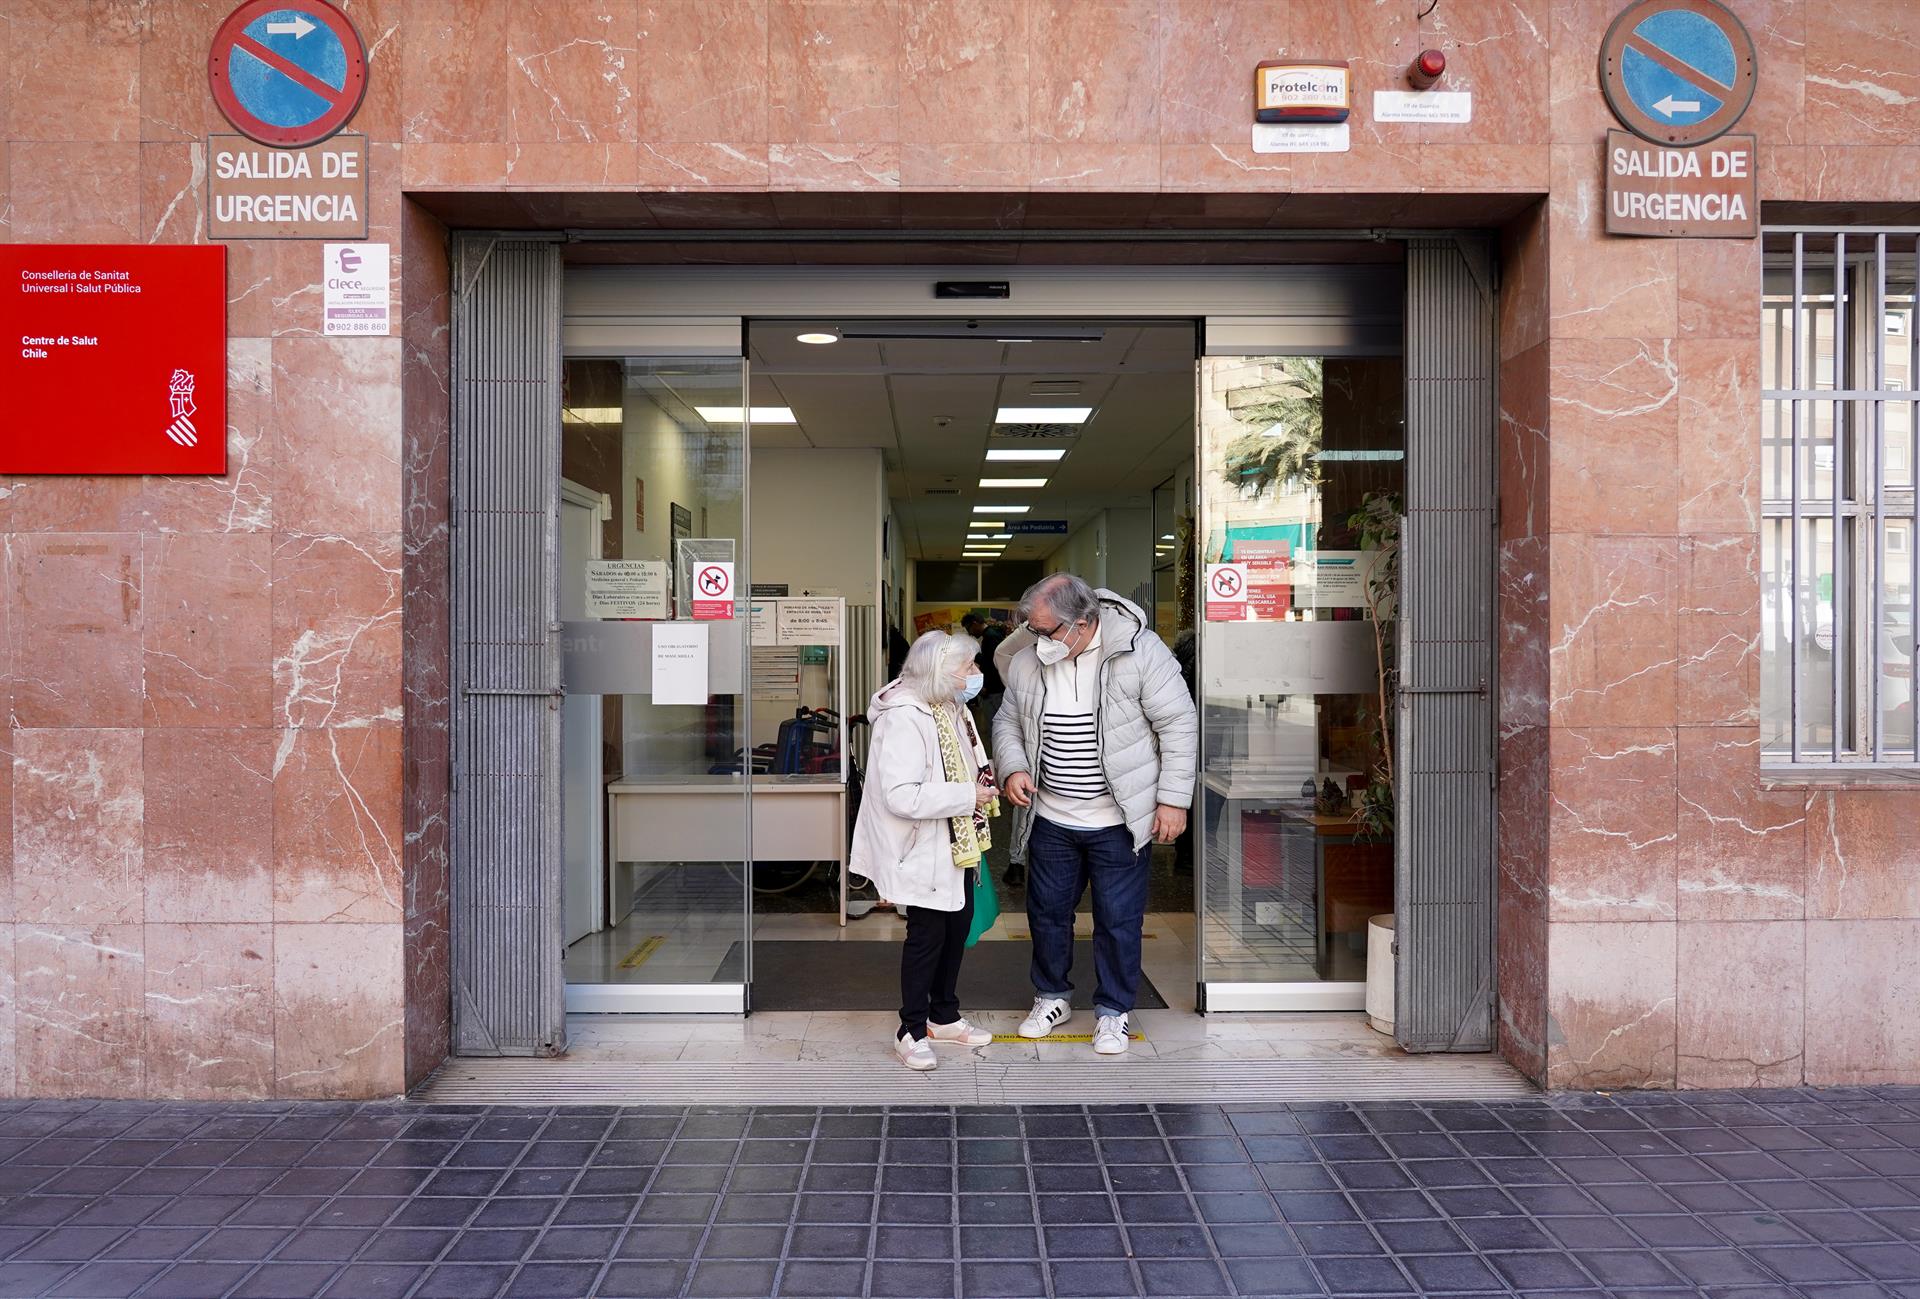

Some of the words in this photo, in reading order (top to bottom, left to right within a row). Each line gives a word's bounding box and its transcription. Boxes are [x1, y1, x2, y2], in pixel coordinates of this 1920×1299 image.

[1271, 81, 1338, 93] Protelcom
[216, 151, 313, 179] SALIDA
[322, 151, 359, 179] DE
[1613, 148, 1702, 178] SALIDA
[1711, 151, 1748, 178] DE
[216, 195, 359, 223] URGENCIA
[1613, 191, 1748, 222] URGENCIA
[21, 270, 77, 281] Conselleria
[79, 270, 92, 281] de
[94, 270, 130, 281] Sanitat
[21, 283, 69, 294] Universal
[70, 283, 74, 294] i
[76, 283, 102, 294] Salut
[104, 283, 142, 294] Pública
[328, 278, 363, 290] Clece
[336, 323, 352, 331] 902
[21, 336, 55, 346] Centre
[57, 336, 70, 346] de
[72, 336, 98, 346] Salut
[21, 348, 48, 359] Chile
